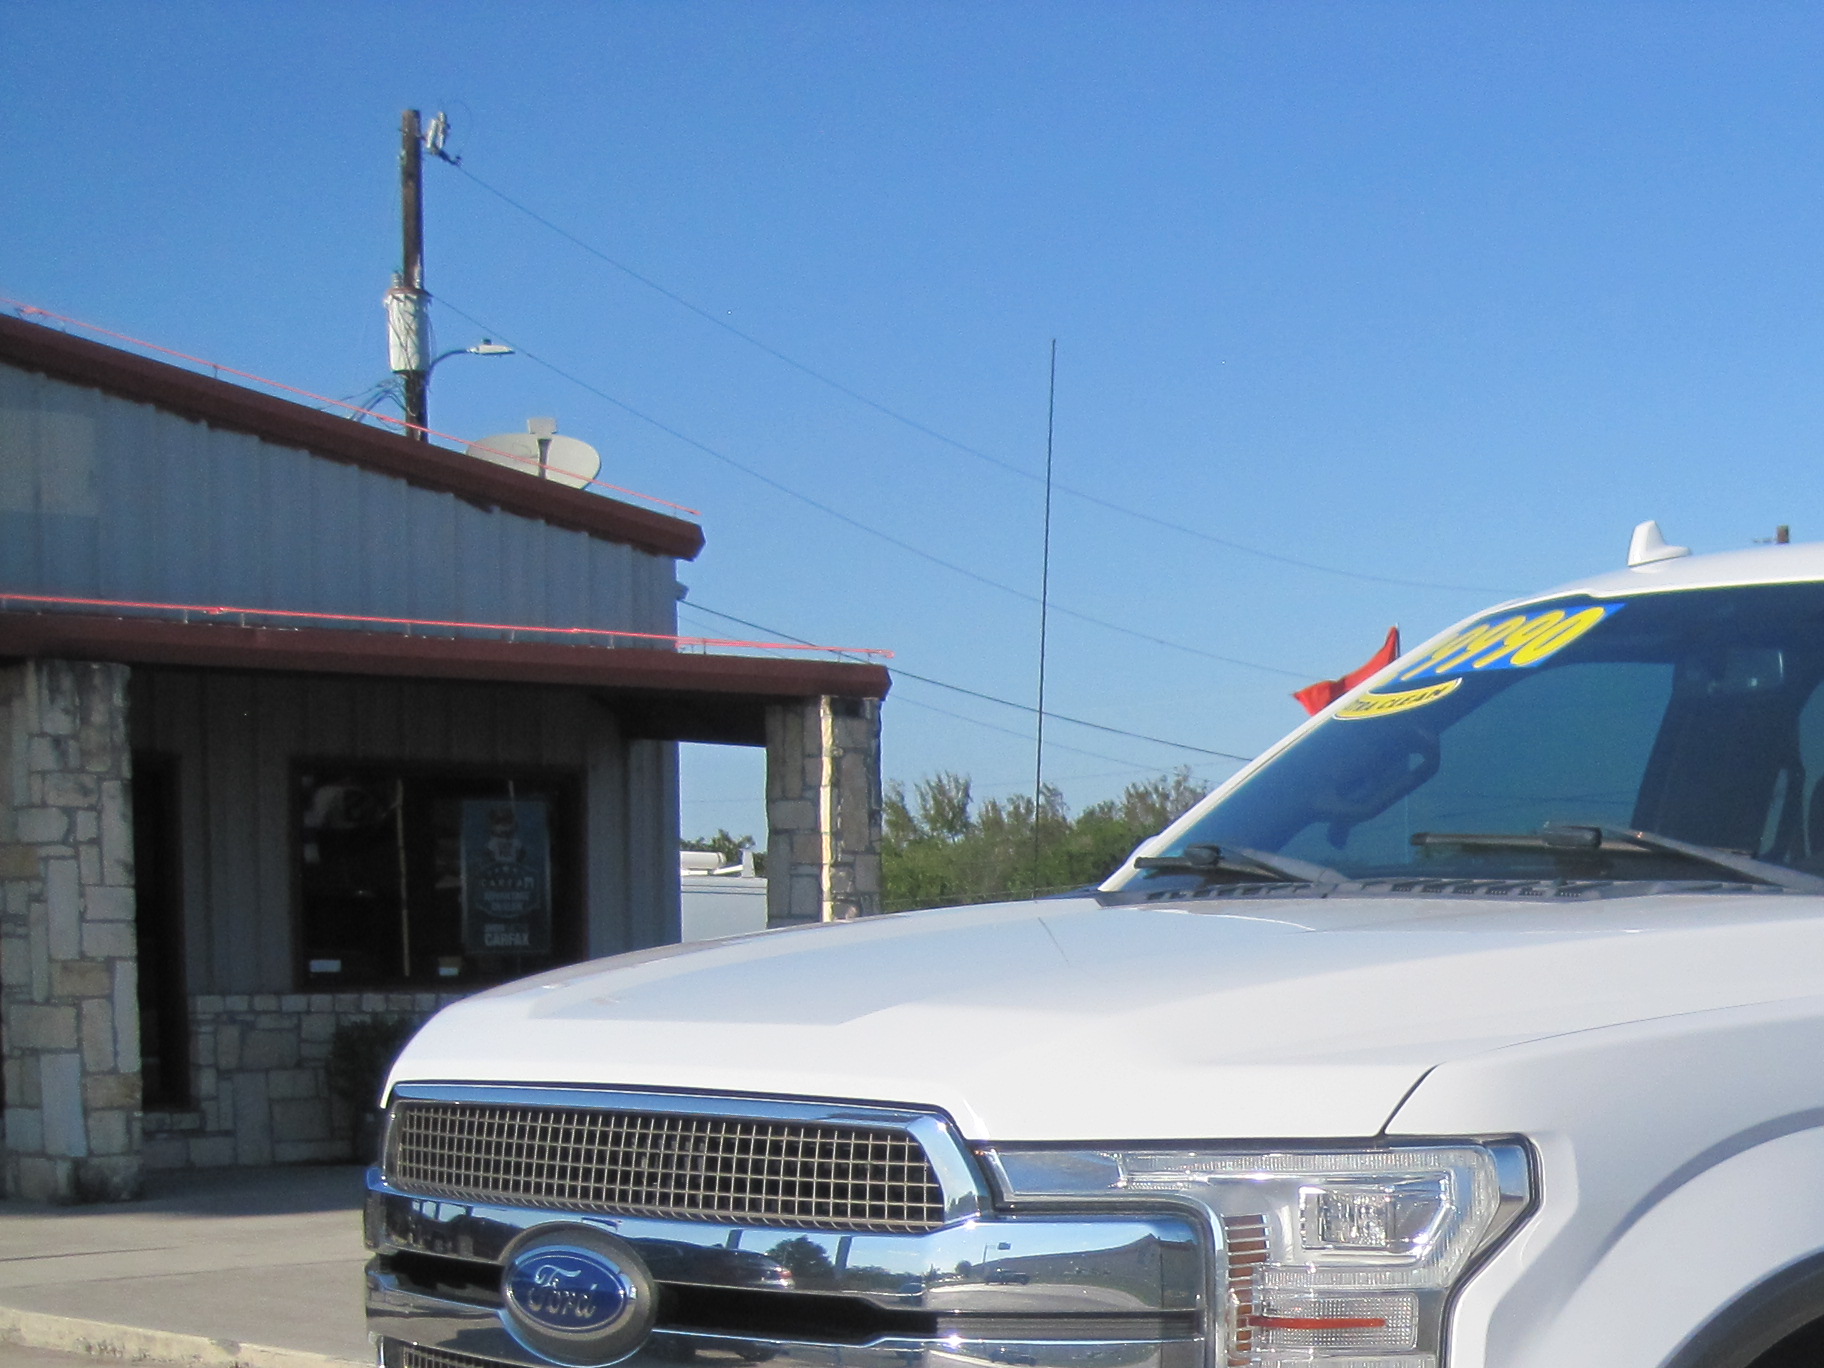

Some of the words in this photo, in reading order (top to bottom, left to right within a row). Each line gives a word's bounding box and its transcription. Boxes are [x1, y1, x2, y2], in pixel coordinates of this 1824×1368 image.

[1370, 606, 1605, 691] 9990
[1377, 686, 1449, 710] CLEAN
[484, 932, 530, 946] CARFAX
[528, 1264, 598, 1318] Ford
